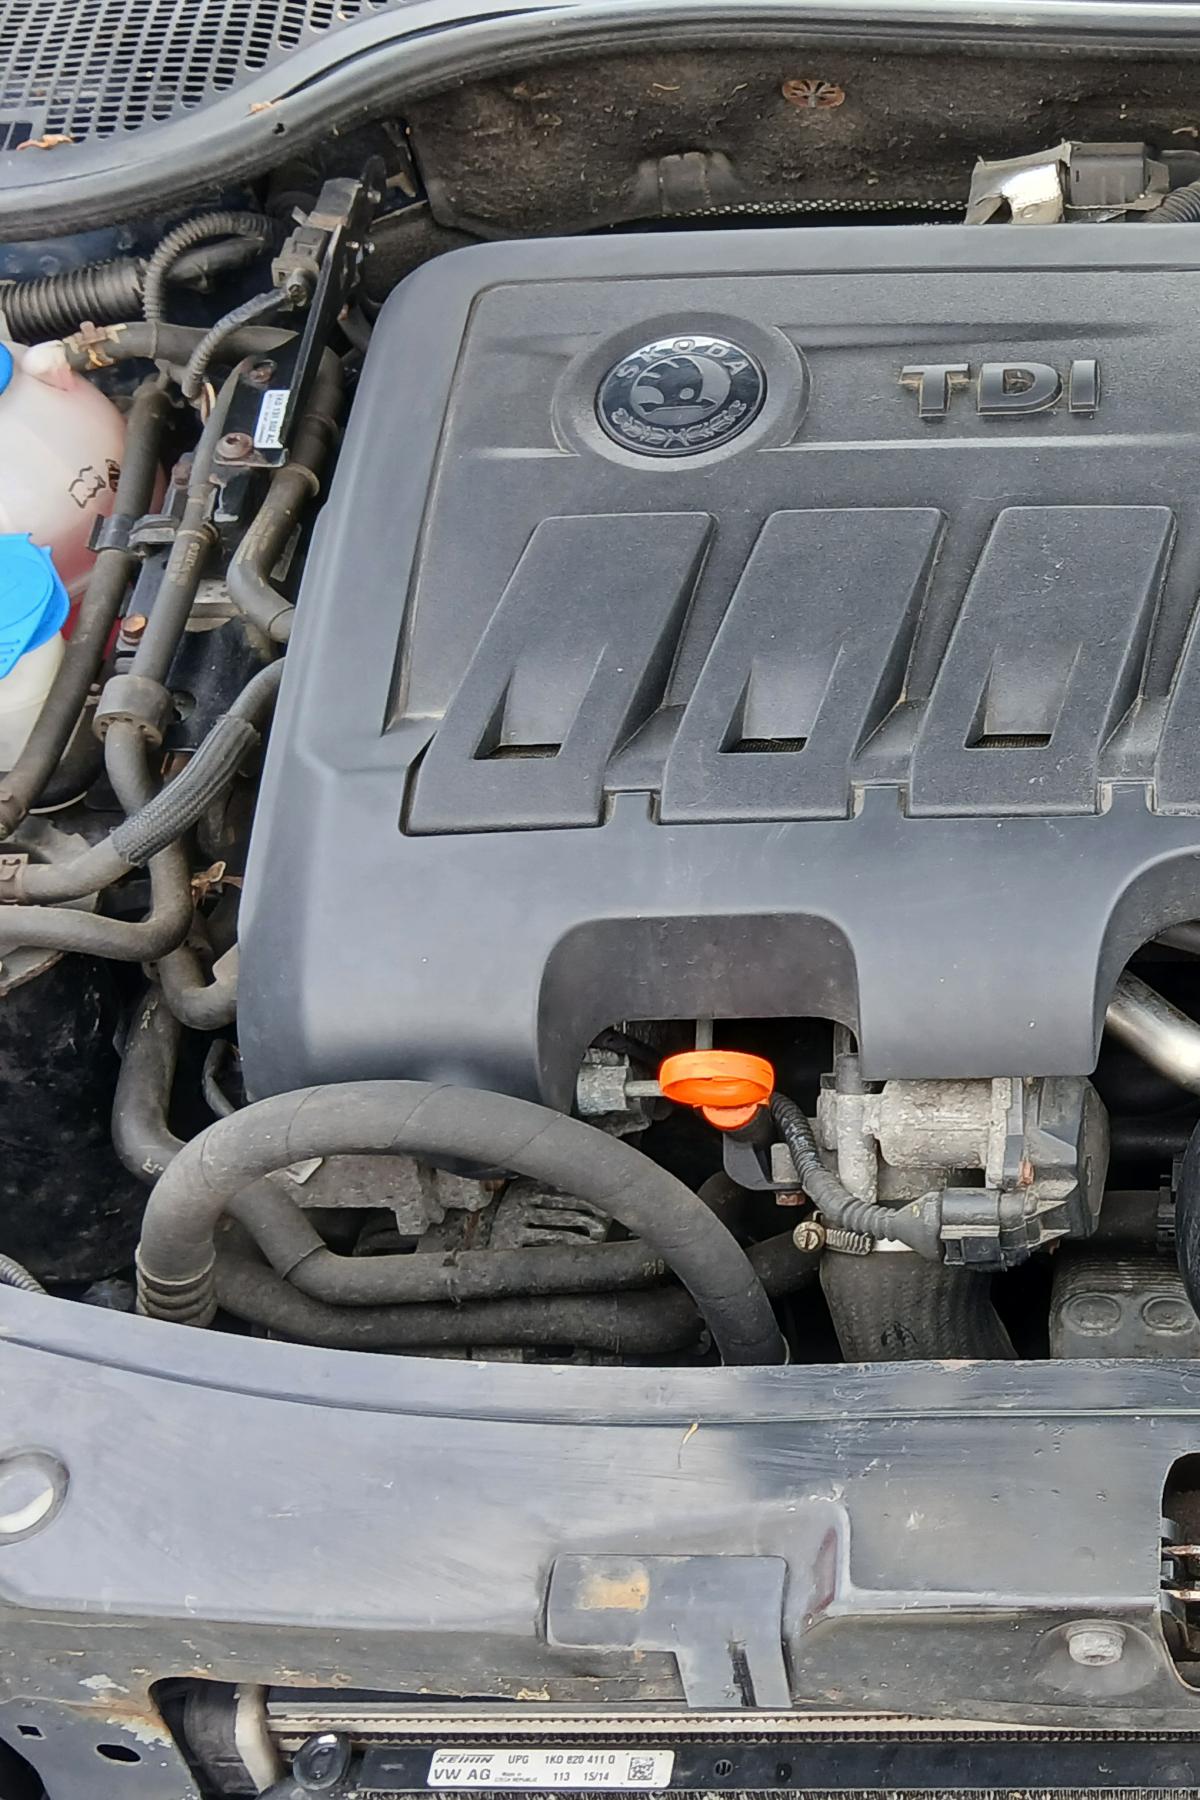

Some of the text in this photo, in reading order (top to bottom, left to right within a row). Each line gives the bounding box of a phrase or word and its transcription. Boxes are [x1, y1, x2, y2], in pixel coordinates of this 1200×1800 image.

[898, 360, 1100, 417] TDI
[508, 1755, 529, 1764] UPG
[567, 1755, 584, 1764] 820
[587, 1755, 604, 1764] 411
[434, 1768, 491, 1780] VW AG
[553, 1771, 571, 1781] 113
[584, 1771, 610, 1782] 15/14
